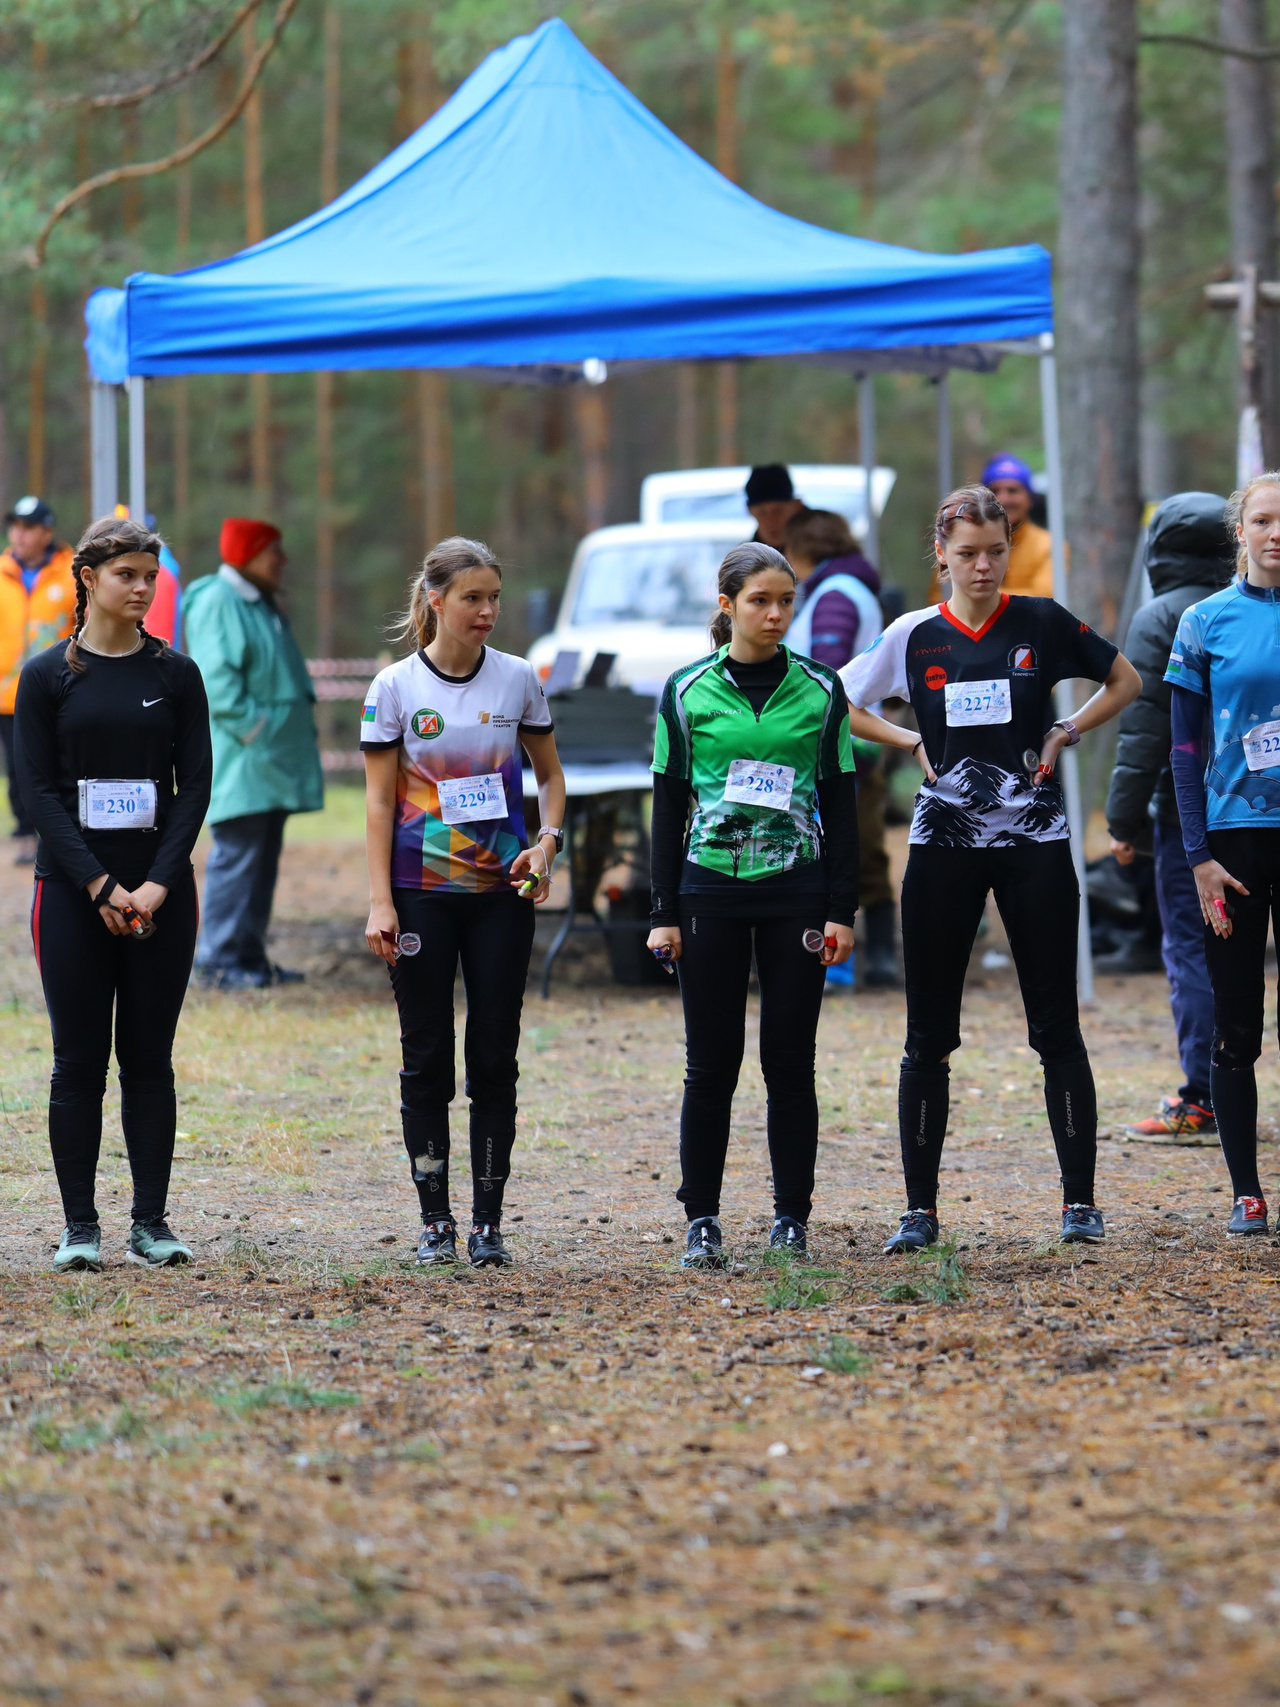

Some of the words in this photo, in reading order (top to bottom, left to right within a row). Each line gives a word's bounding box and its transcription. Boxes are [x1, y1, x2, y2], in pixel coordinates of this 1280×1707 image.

[964, 696, 991, 711] 227
[746, 776, 774, 793] 228
[106, 798, 136, 814] 230
[458, 791, 486, 808] 229
[1065, 1090, 1073, 1126] NORD
[919, 1099, 927, 1135] NORD
[485, 1137, 493, 1177] NORD
